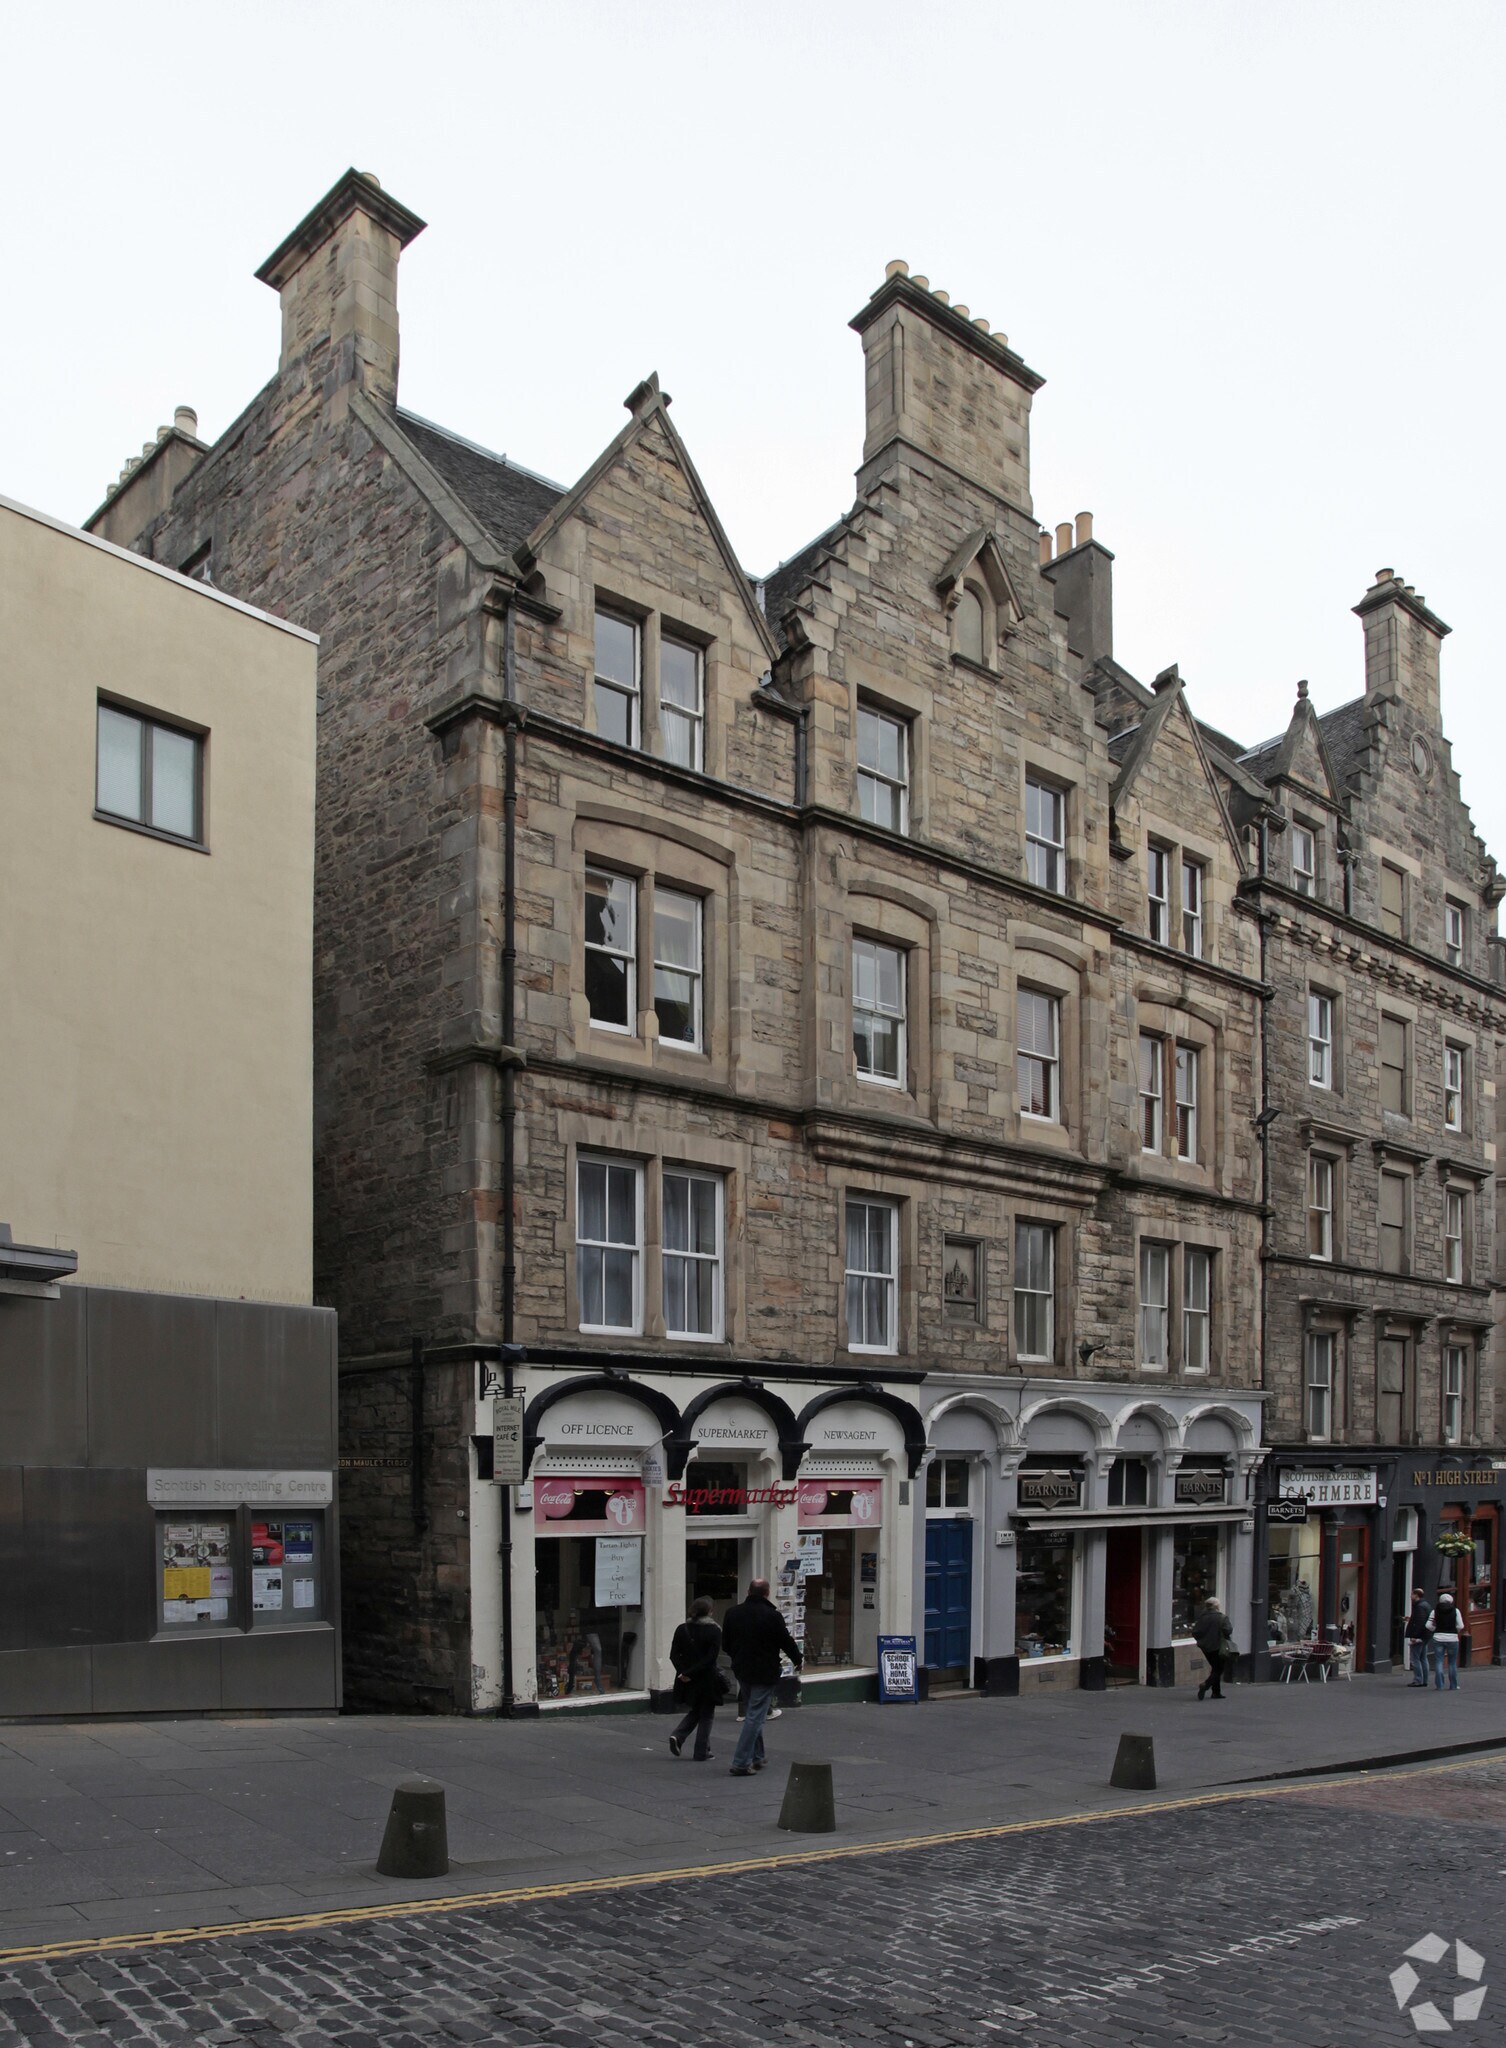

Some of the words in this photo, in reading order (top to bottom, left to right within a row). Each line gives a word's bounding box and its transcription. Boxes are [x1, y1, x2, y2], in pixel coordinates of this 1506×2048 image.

[561, 1423, 583, 1435] OFF
[586, 1424, 634, 1436] LICENCE
[698, 1428, 769, 1439] SUPERMARKET
[823, 1430, 877, 1440] NEWSAGENT
[496, 1432, 509, 1441] CAFÉ
[1285, 1471, 1324, 1482] SCOTTISH
[1326, 1470, 1372, 1481] EXPERIENCE
[1435, 1471, 1461, 1485] HIGH
[1464, 1470, 1499, 1484] STREET
[154, 1478, 207, 1492] Scottish
[213, 1479, 283, 1495] Storytelling
[288, 1480, 327, 1492] Centre
[1028, 1485, 1077, 1497] BARNETS
[1182, 1482, 1223, 1494] BARNETS
[663, 1479, 799, 1513] Supermarket
[1286, 1484, 1372, 1502] CASHMERE
[609, 1591, 627, 1600] Free
[887, 1678, 911, 1686] BAKING
